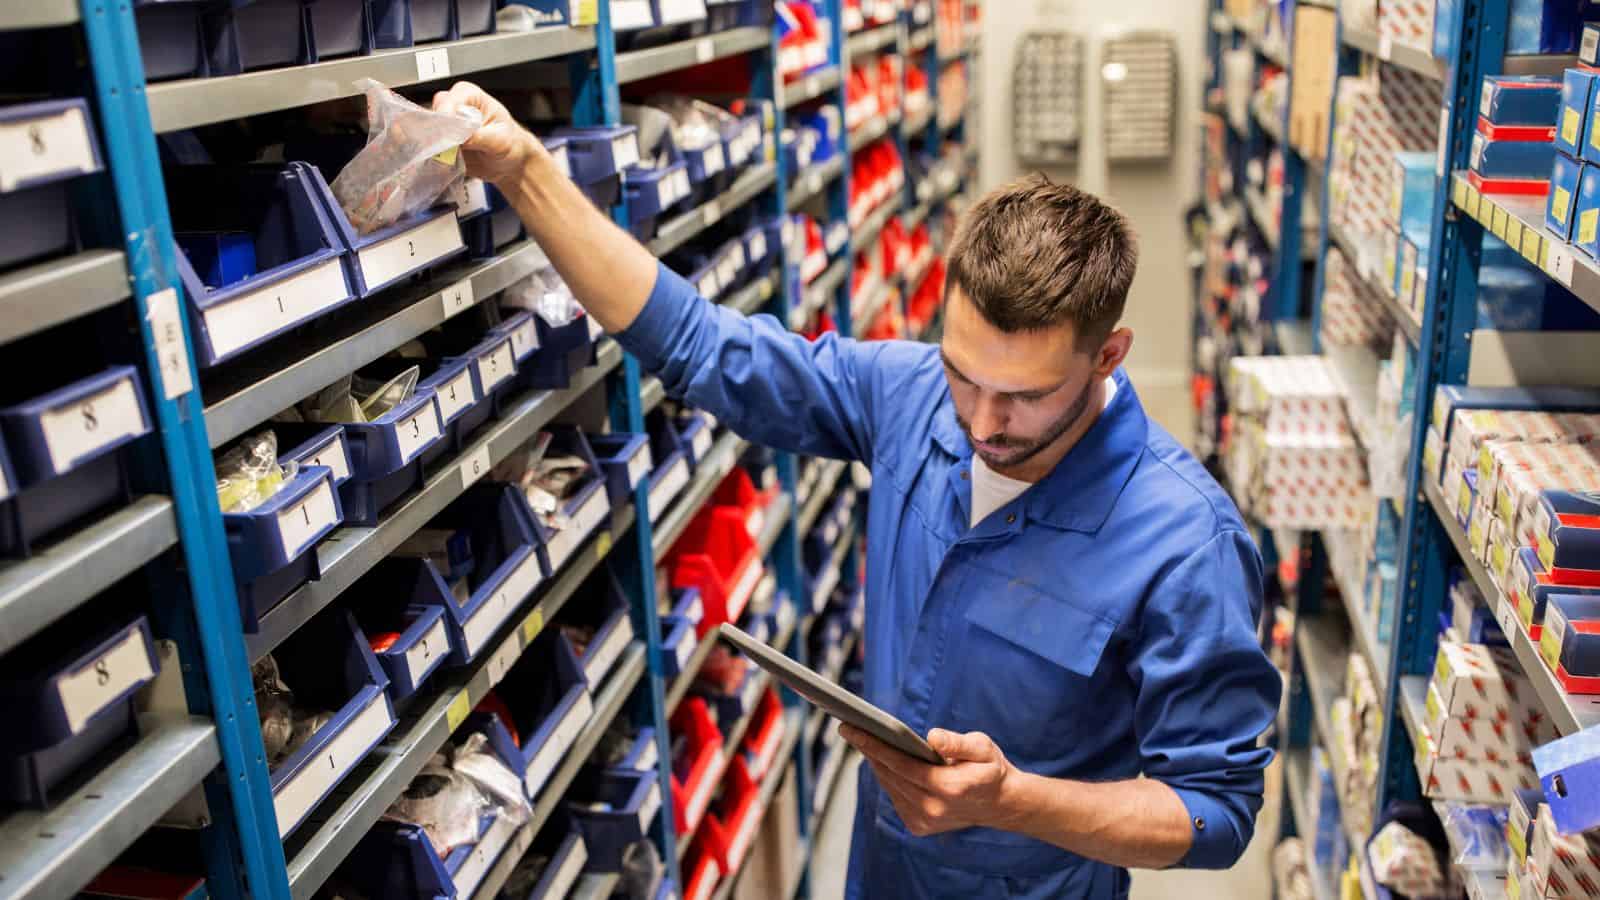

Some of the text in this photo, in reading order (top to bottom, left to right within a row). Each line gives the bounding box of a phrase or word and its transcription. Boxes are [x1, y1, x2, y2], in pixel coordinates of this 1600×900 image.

[407, 240, 415, 257] 2
[276, 295, 284, 313] 1
[455, 291, 463, 306] H
[449, 384, 456, 401] 4
[80, 400, 98, 432] 8
[411, 417, 420, 439] 3
[301, 504, 310, 526] 1
[421, 639, 431, 659] 2
[95, 658, 110, 687] 8
[328, 753, 336, 770] 1
